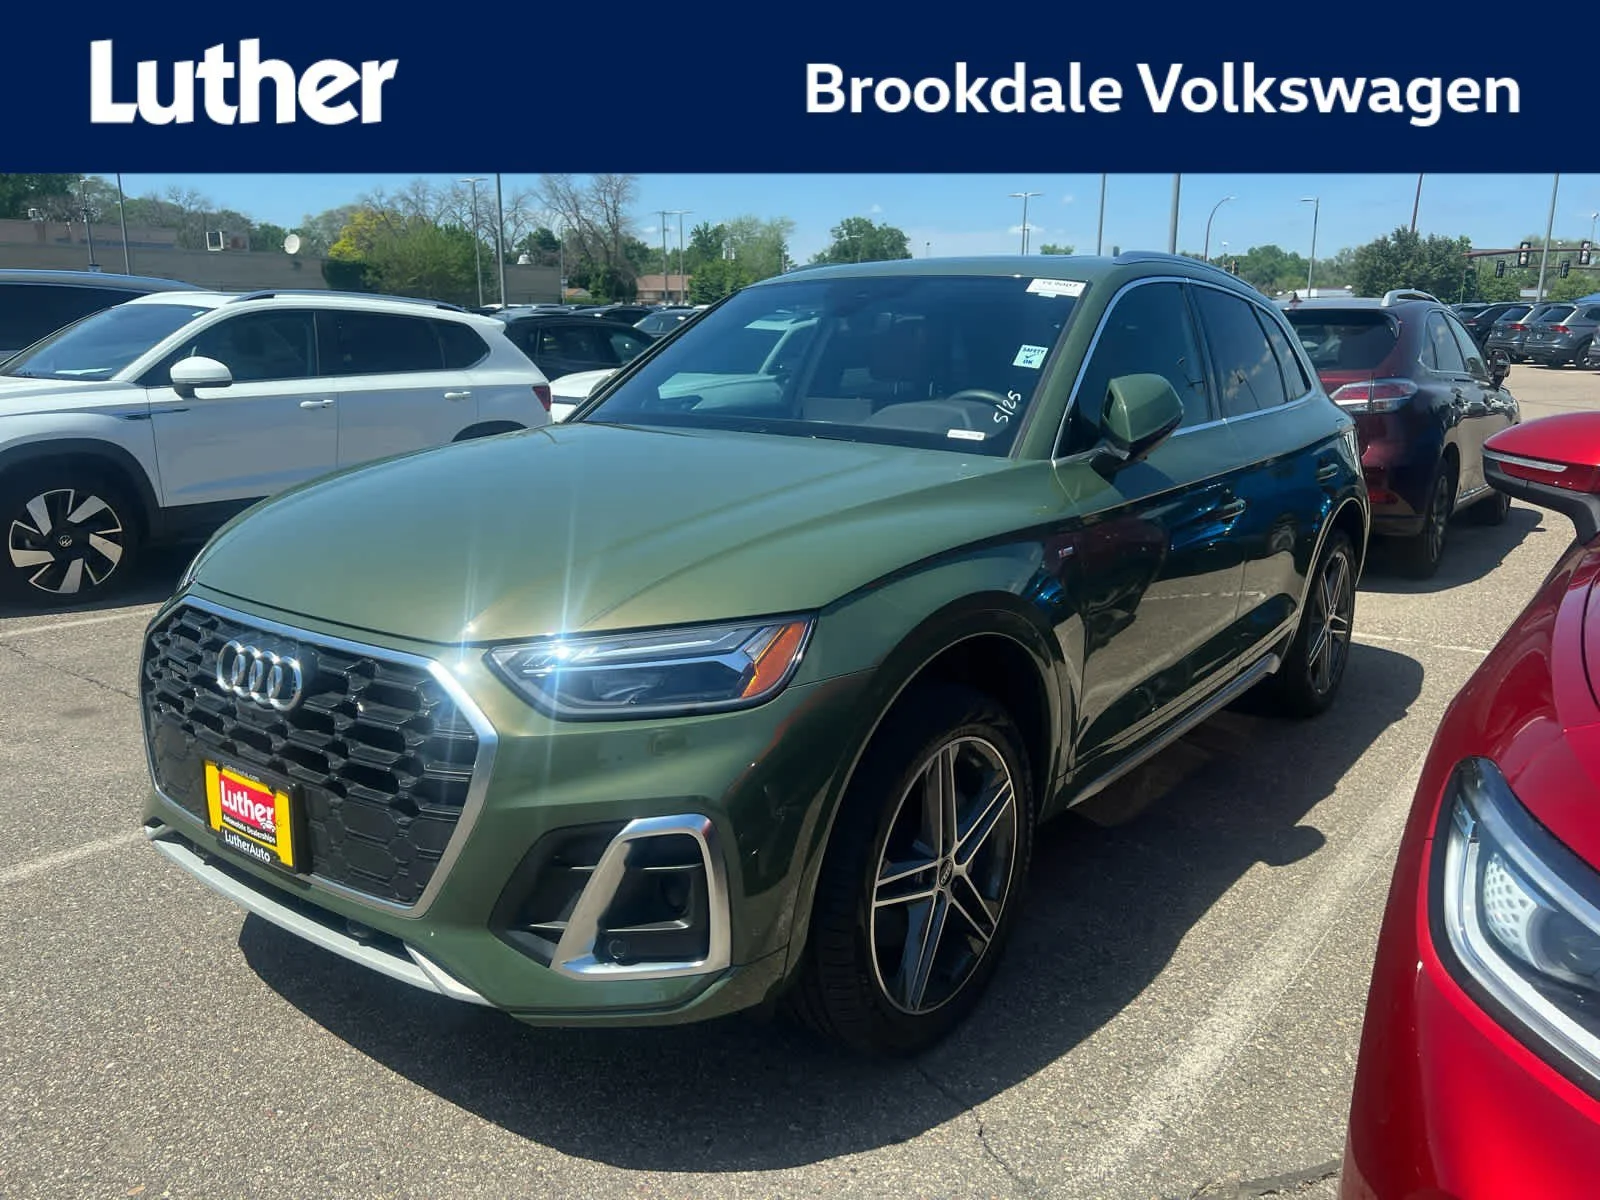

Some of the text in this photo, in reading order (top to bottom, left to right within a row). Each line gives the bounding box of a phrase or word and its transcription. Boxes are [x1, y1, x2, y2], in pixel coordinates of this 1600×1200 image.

[1022, 347, 1046, 355] SAFETY
[993, 390, 1022, 424] 5/25
[220, 780, 275, 823] Luther
[224, 829, 271, 863] LutherAuto
